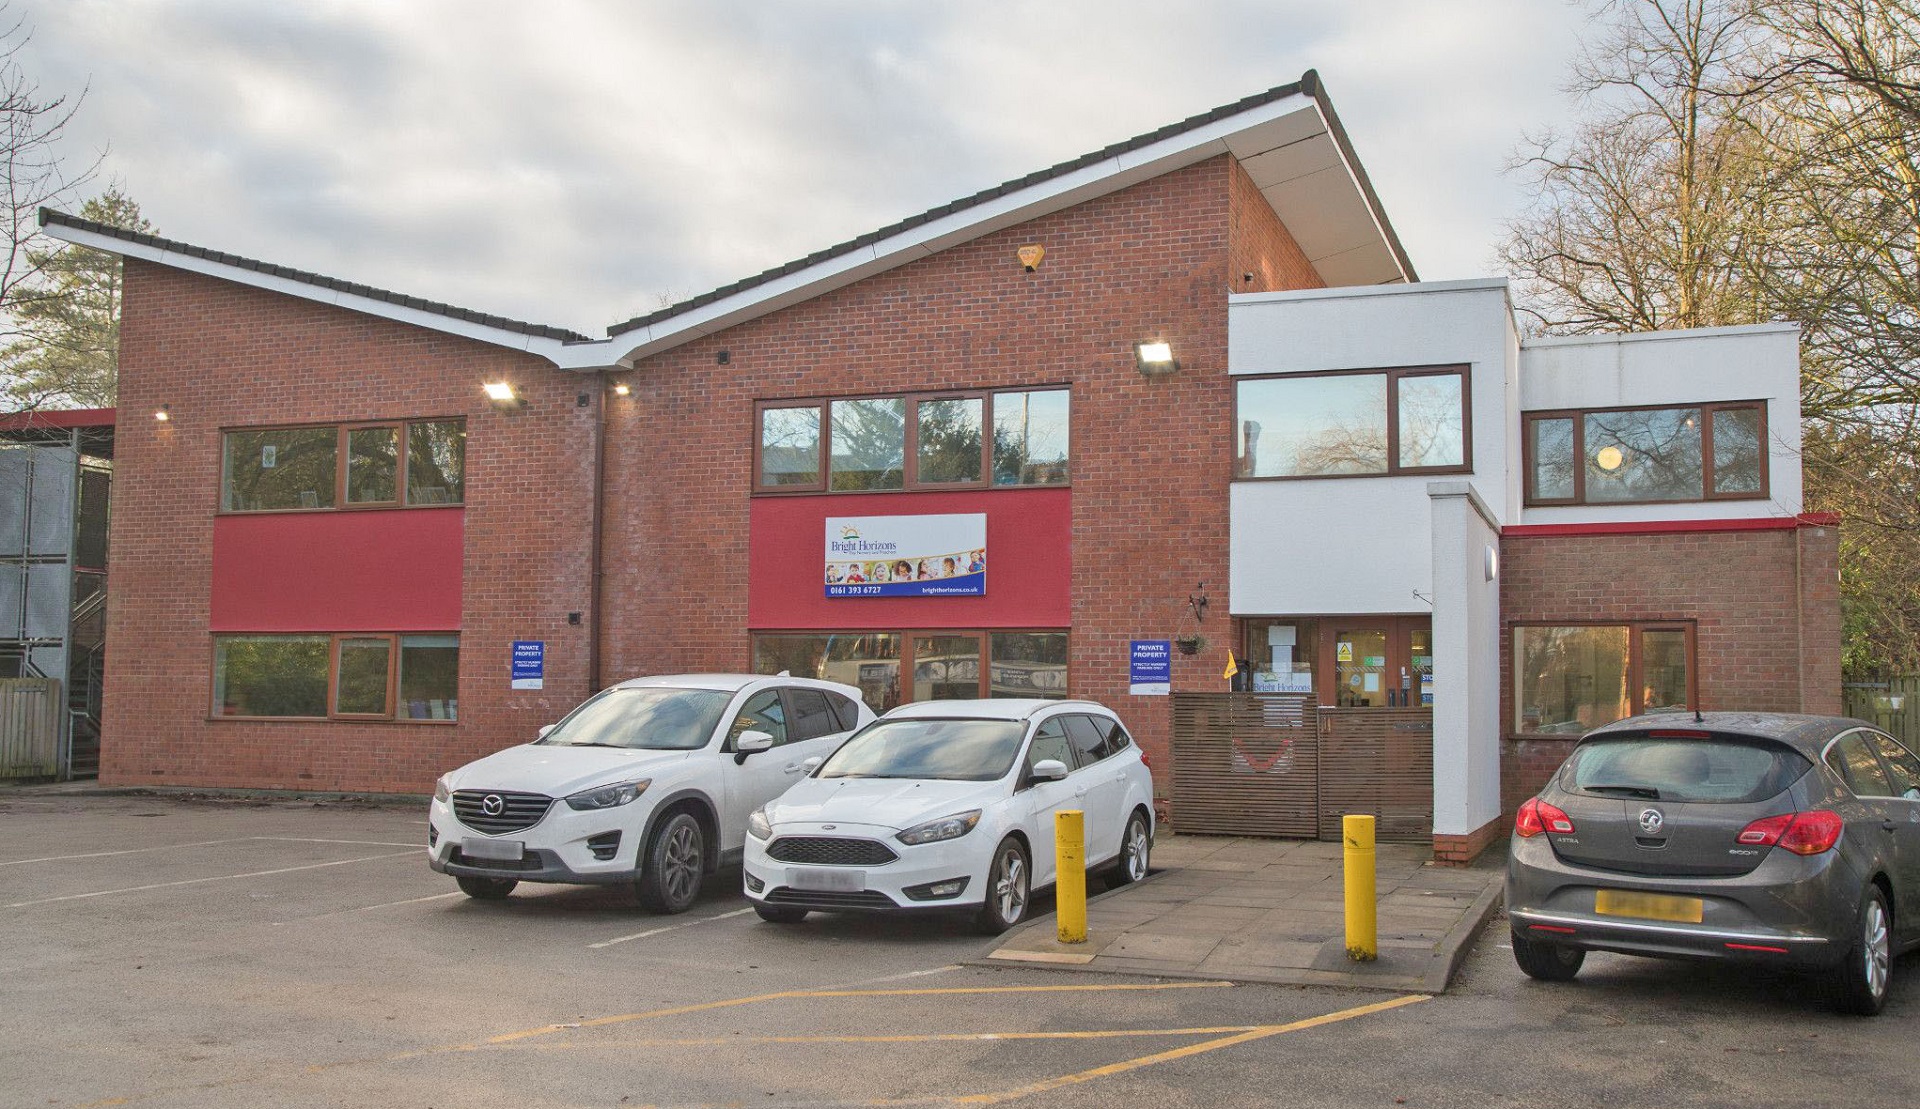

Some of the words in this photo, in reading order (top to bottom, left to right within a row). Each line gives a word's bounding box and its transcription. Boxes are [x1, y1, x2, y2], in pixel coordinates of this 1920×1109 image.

[831, 540, 856, 554] Bright
[859, 540, 897, 550] Horizons
[830, 586, 846, 594] 0161
[848, 586, 861, 594] 393
[863, 586, 881, 594] 6727
[1254, 683, 1276, 692] Bright
[1277, 683, 1311, 692] Horizons
